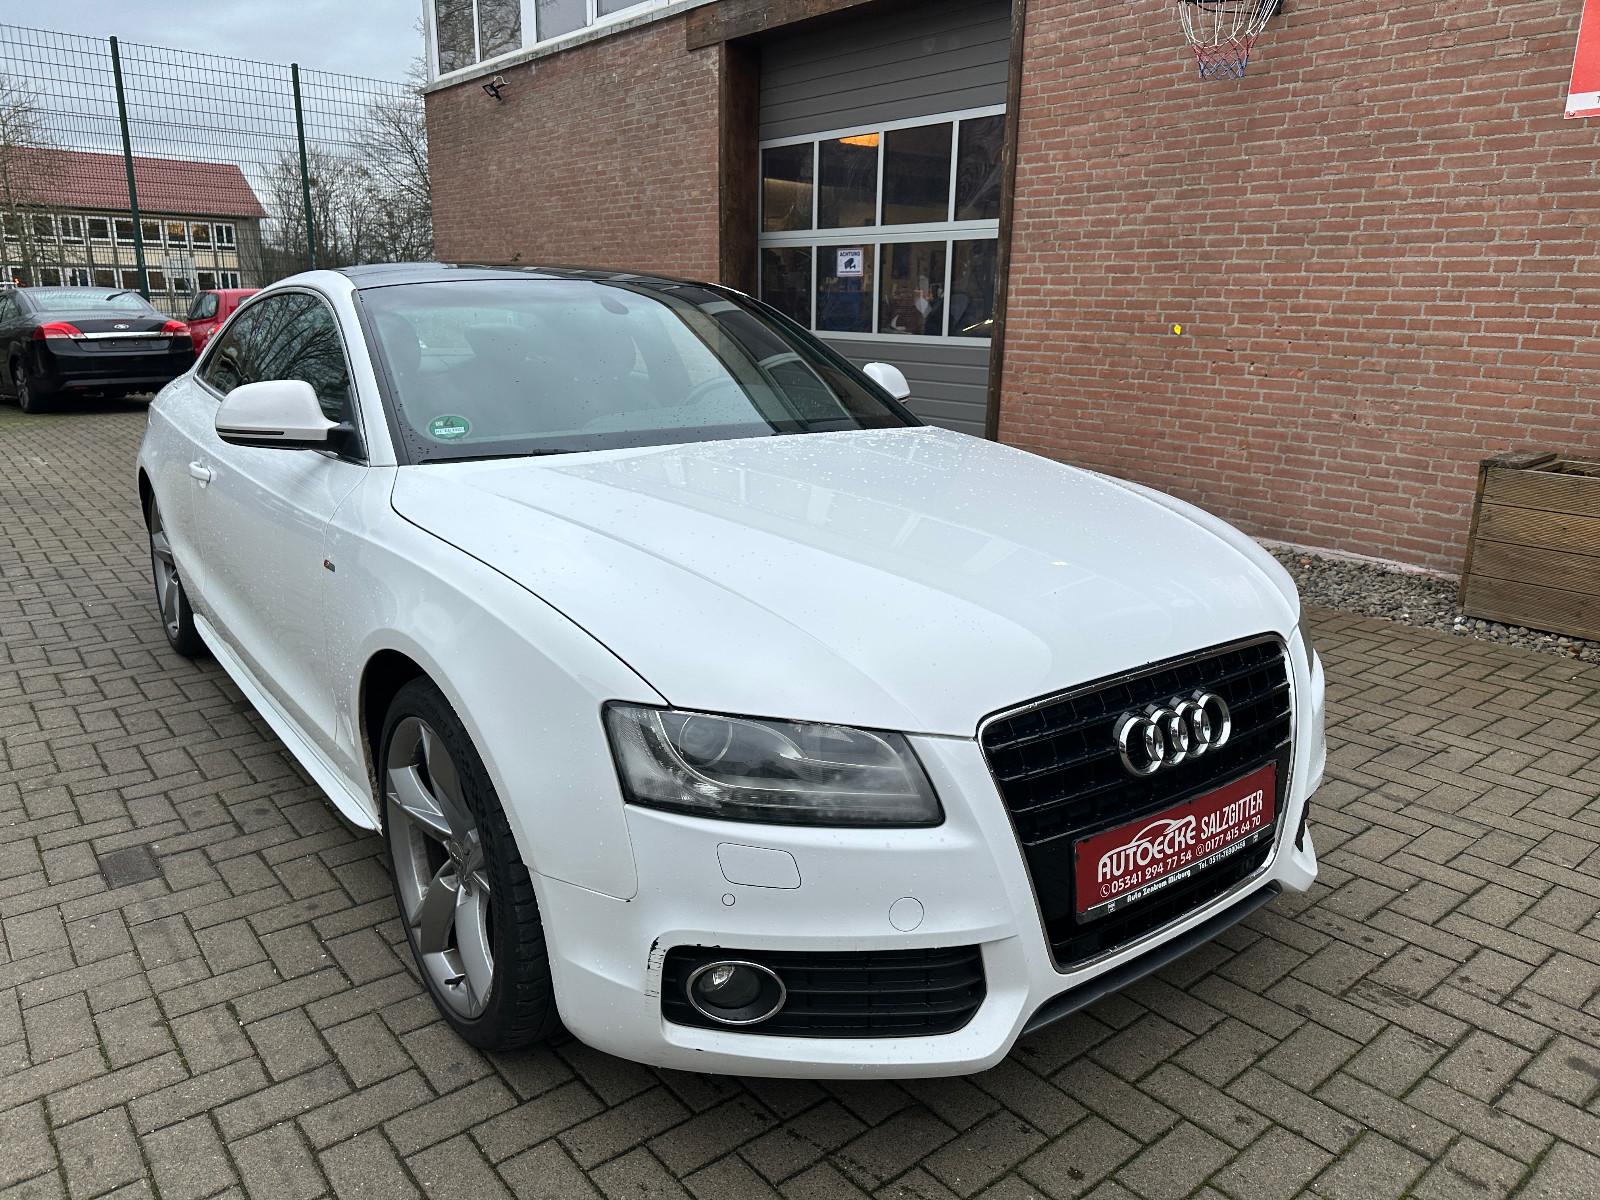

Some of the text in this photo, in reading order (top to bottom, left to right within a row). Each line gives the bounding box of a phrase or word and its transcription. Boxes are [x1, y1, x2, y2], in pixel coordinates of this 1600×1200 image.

[1098, 789, 1263, 883] AUTOECKE SALZGITTER
[1111, 815, 1261, 893] 05341 294 77 54 0177 415 64 70
[1127, 892, 1141, 903] Auto
[1198, 861, 1209, 870] Tel.
